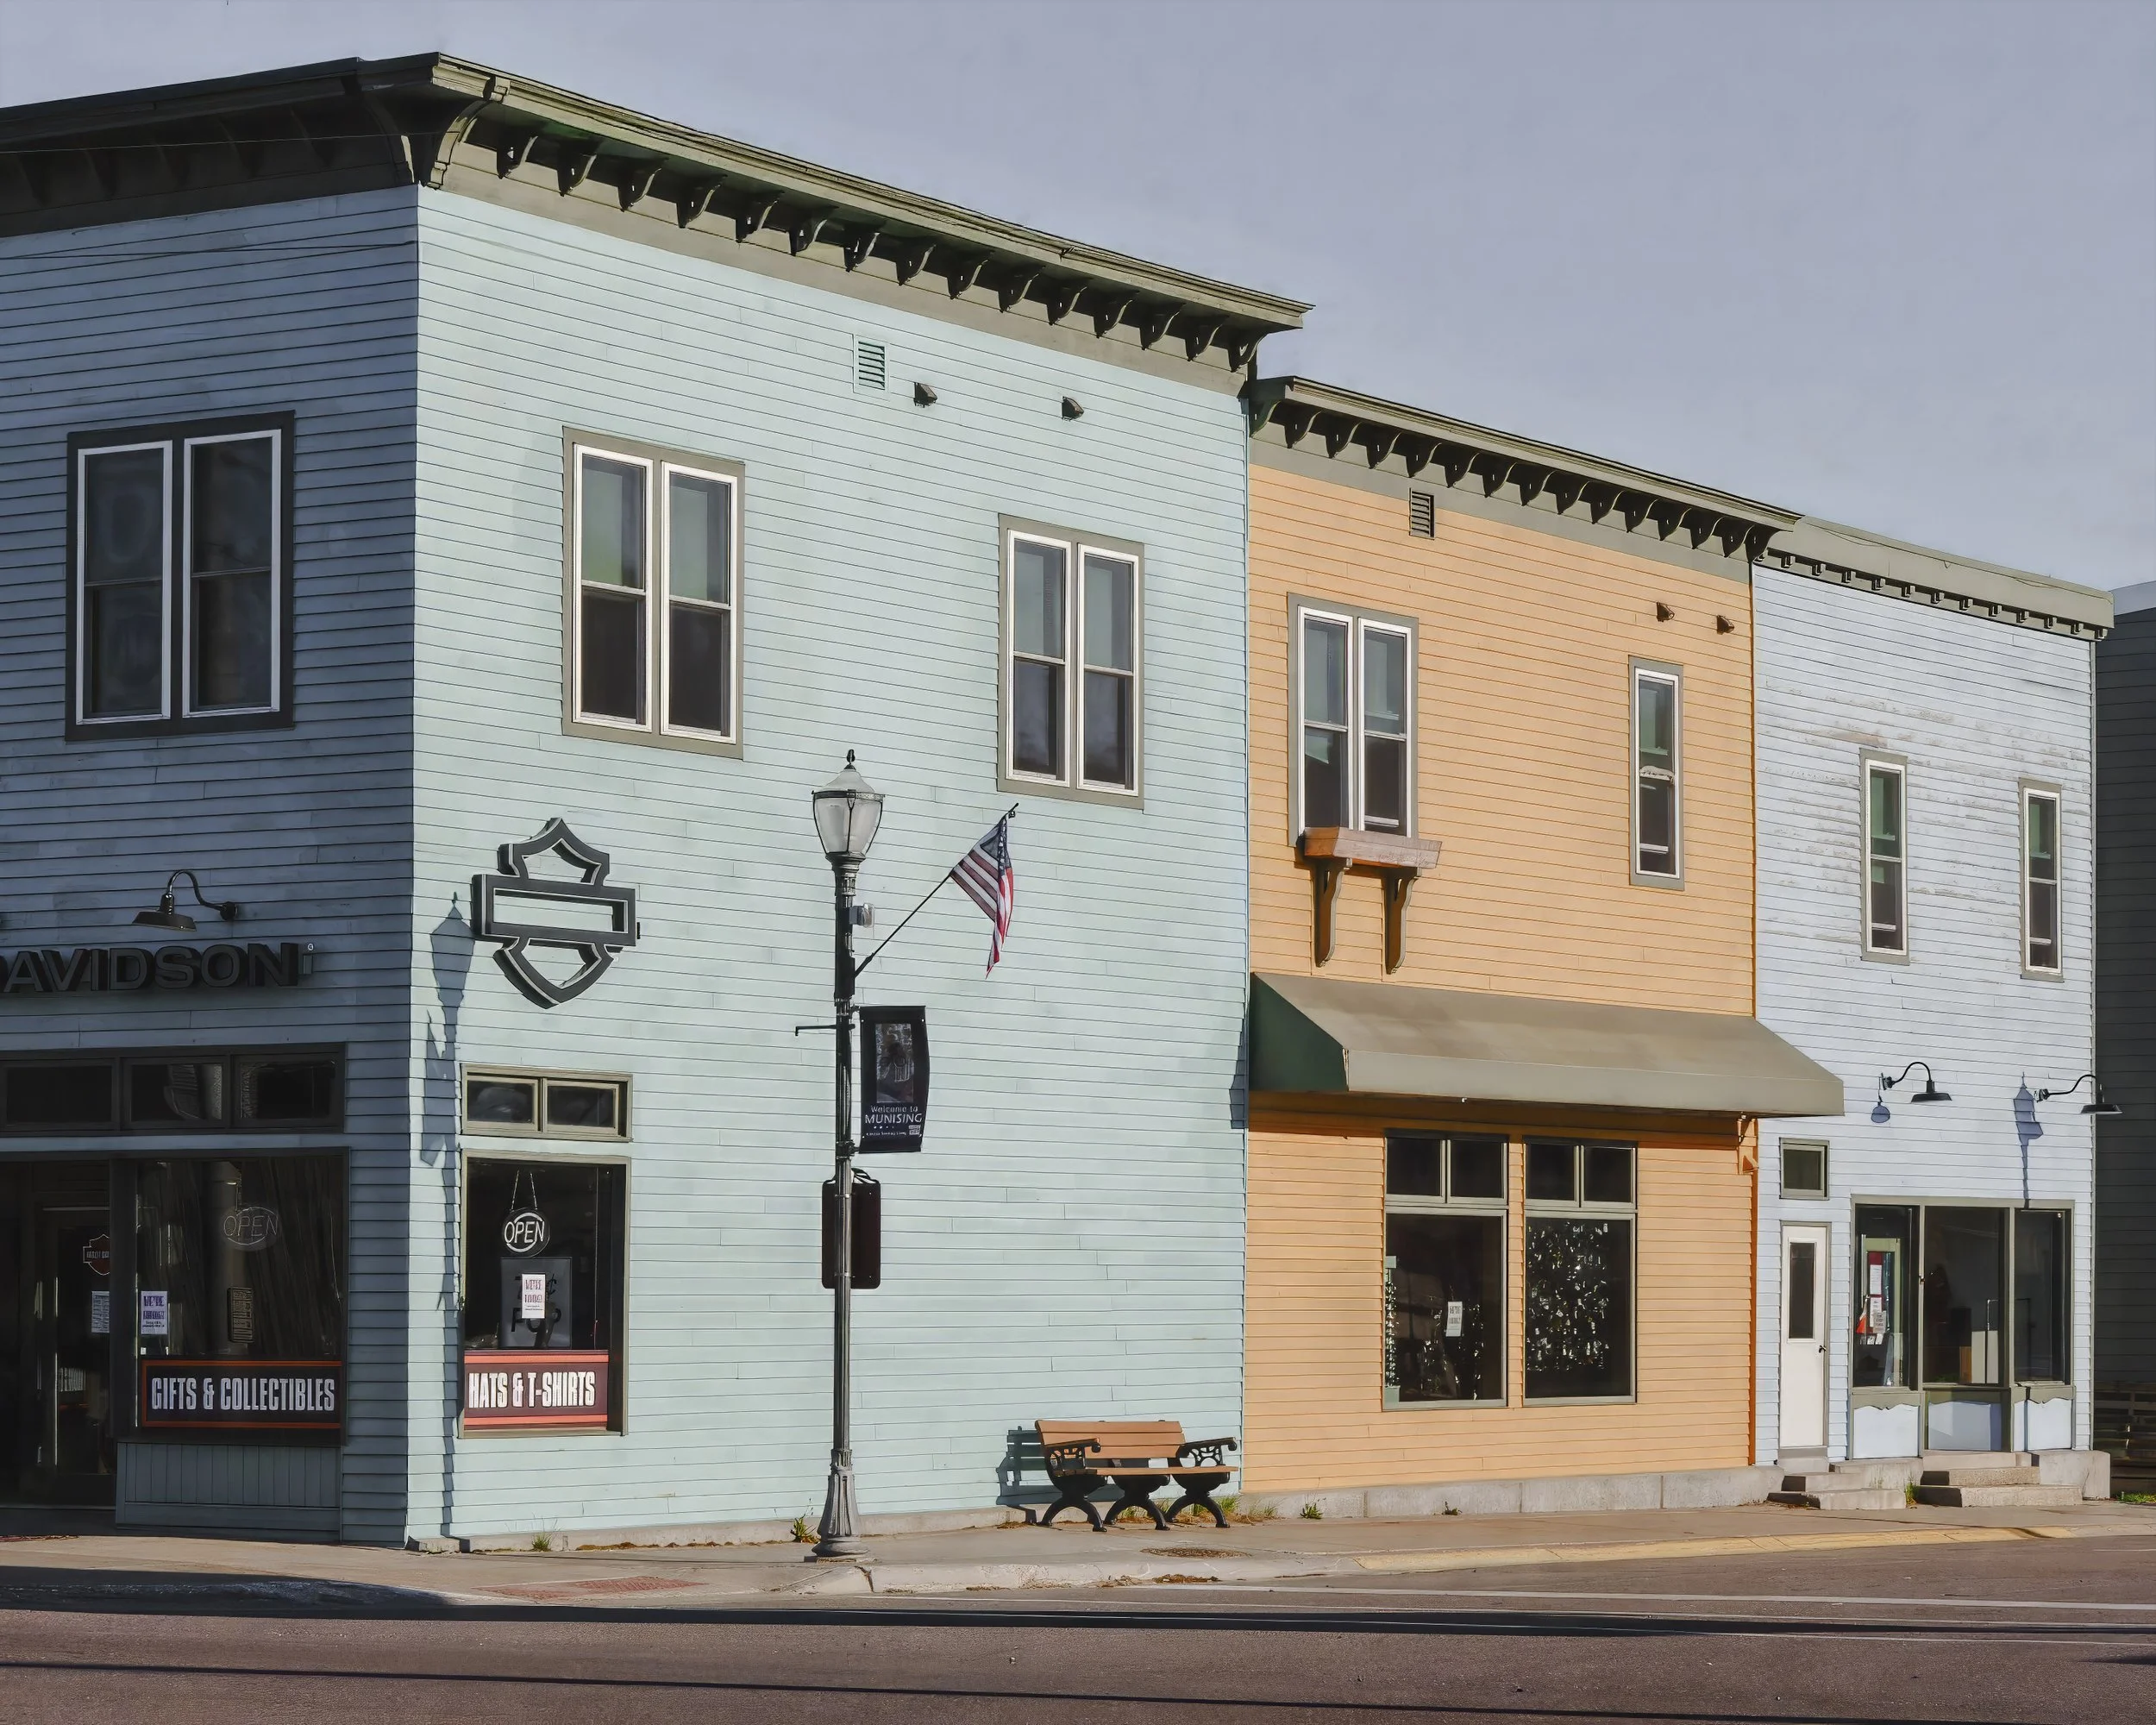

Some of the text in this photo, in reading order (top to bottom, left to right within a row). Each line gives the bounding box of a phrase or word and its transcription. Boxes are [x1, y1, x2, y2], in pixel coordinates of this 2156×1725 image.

[0, 942, 299, 992] AVIDSON
[865, 1113, 922, 1124] MUNISING
[223, 1214, 279, 1239] OPEN
[505, 1220, 545, 1245] OPEN
[151, 1377, 335, 1411] GIFTS & COLLECTIBLES
[468, 1371, 596, 1408] HATS & T-SHIRTS
